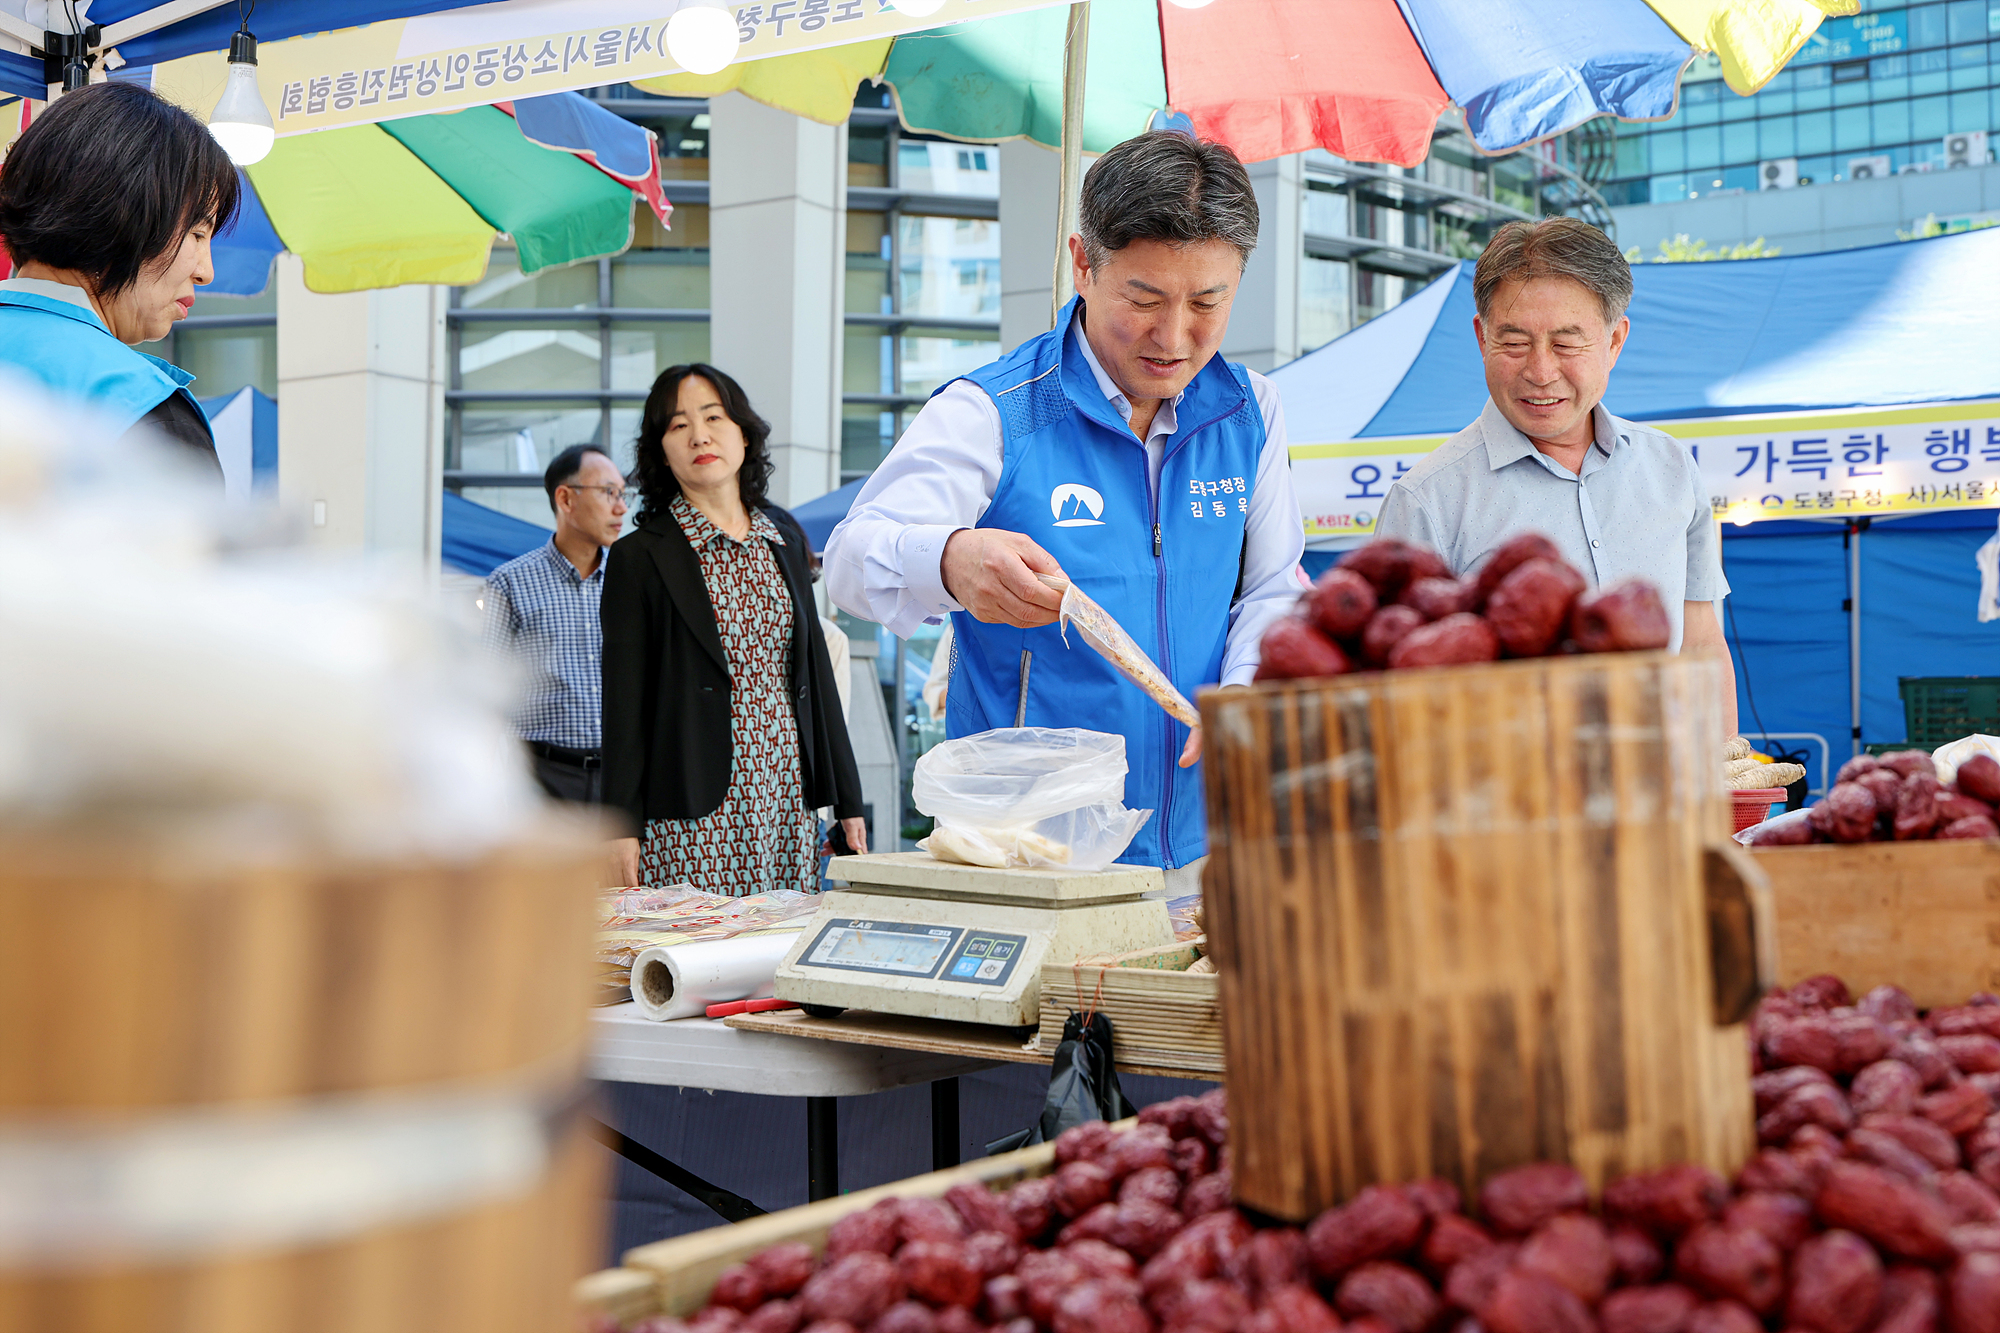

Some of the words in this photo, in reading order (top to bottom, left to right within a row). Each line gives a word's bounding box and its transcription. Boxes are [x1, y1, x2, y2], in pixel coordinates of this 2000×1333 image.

[1735, 434, 1889, 483] 가득한
[1189, 477, 1246, 497] 도봉구청장
[1793, 489, 1892, 509] 도봉구청,
[1190, 501, 1204, 518] 김
[1212, 501, 1226, 518] 동
[1316, 515, 1352, 527] KBIZ
[848, 921, 874, 930] CAS
